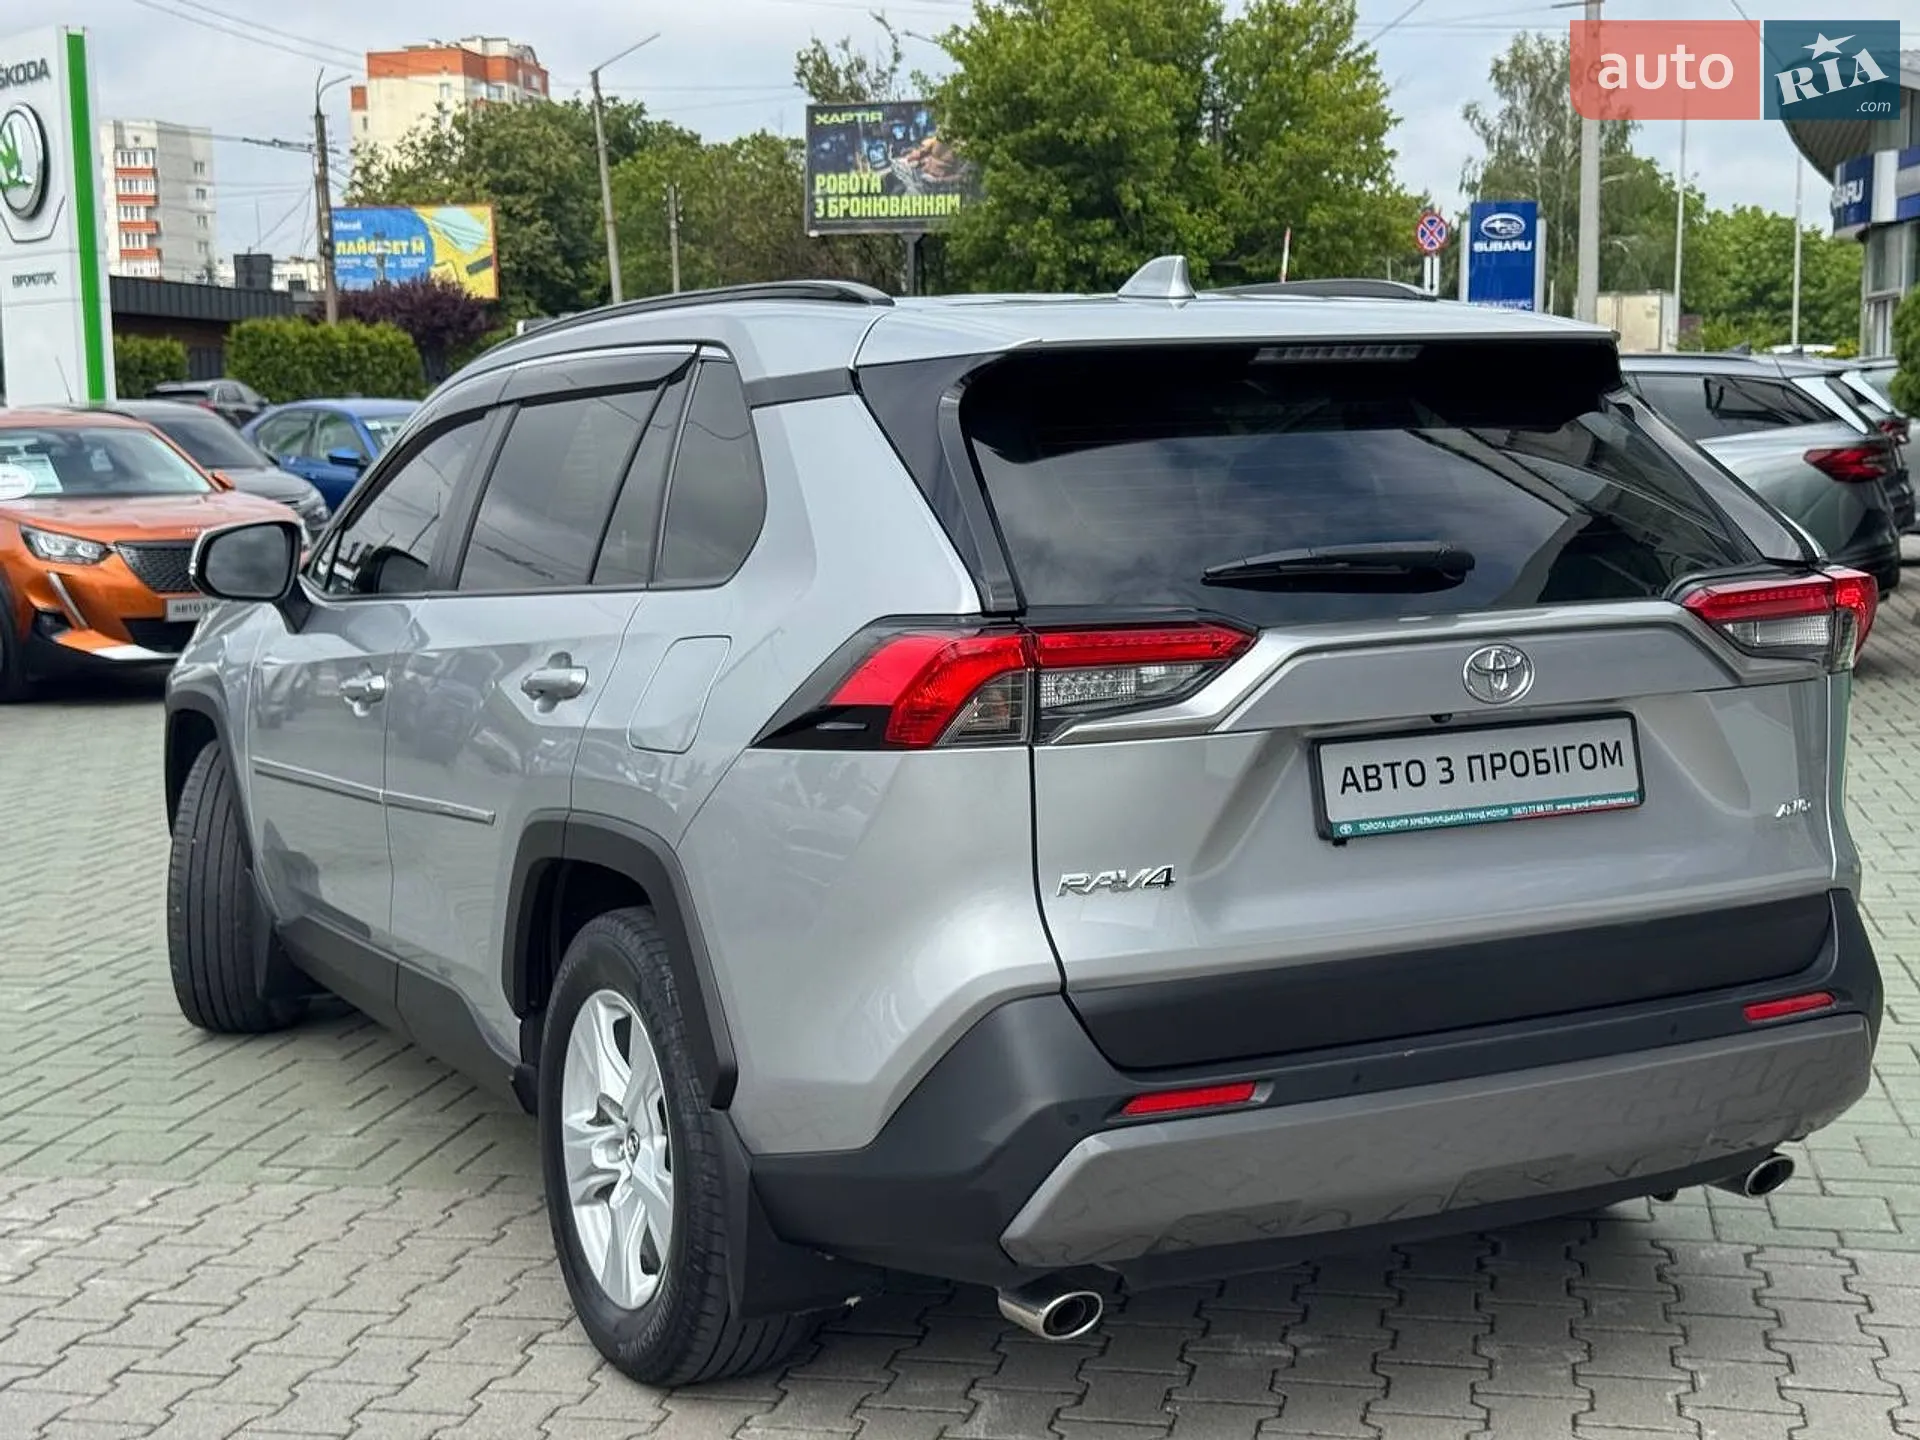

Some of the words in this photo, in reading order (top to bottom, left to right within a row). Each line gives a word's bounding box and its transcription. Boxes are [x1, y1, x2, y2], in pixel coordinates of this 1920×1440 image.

[814, 171, 882, 194] РОБОТА
[828, 193, 961, 218] БРОНЮВАННЯМ
[1473, 240, 1533, 252] SUBARU
[1340, 758, 1427, 795] АВТО
[1467, 740, 1624, 783] ПРОБІГОМ
[1056, 864, 1176, 897] RAV4
